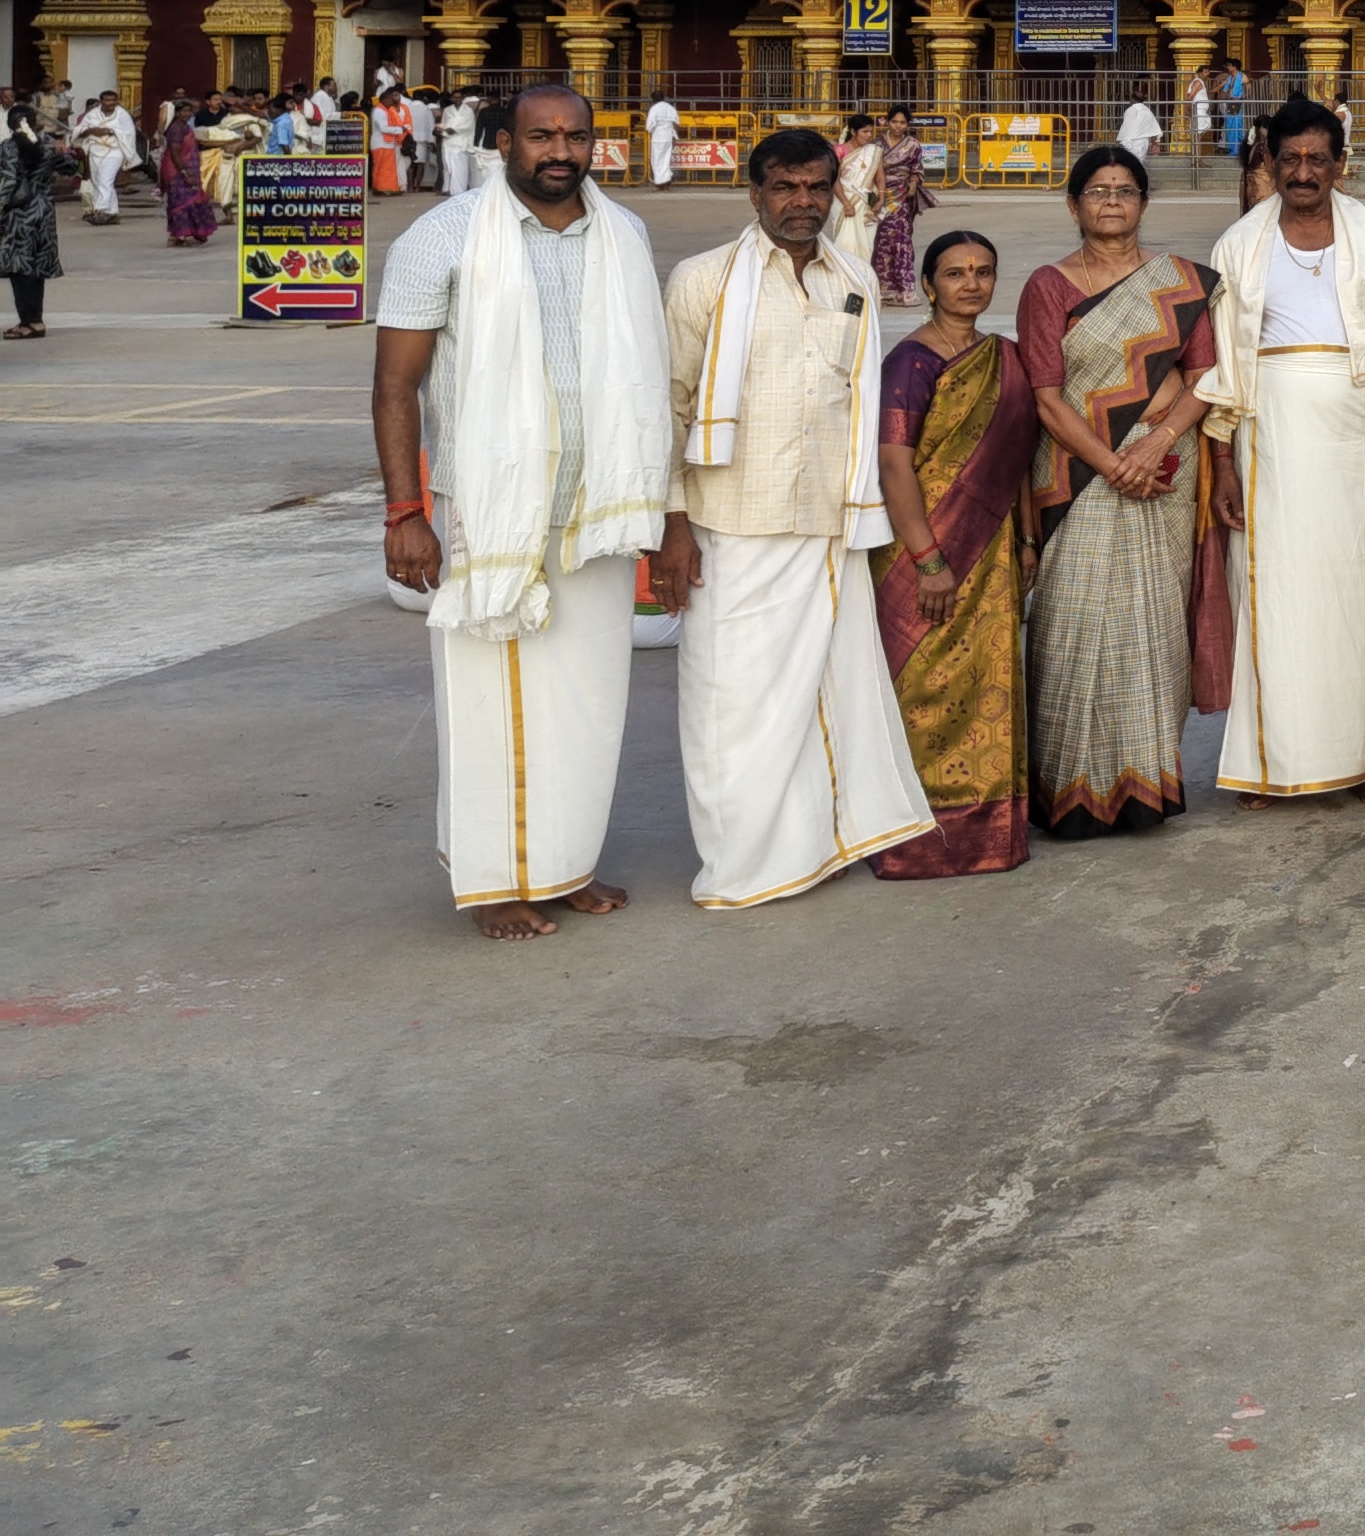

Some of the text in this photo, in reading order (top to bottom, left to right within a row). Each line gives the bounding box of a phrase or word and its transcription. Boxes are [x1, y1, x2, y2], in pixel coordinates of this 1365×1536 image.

[247, 185, 363, 201] LEAVE YOUR FOOTWEAR
[246, 203, 364, 217] IN COUNTER
